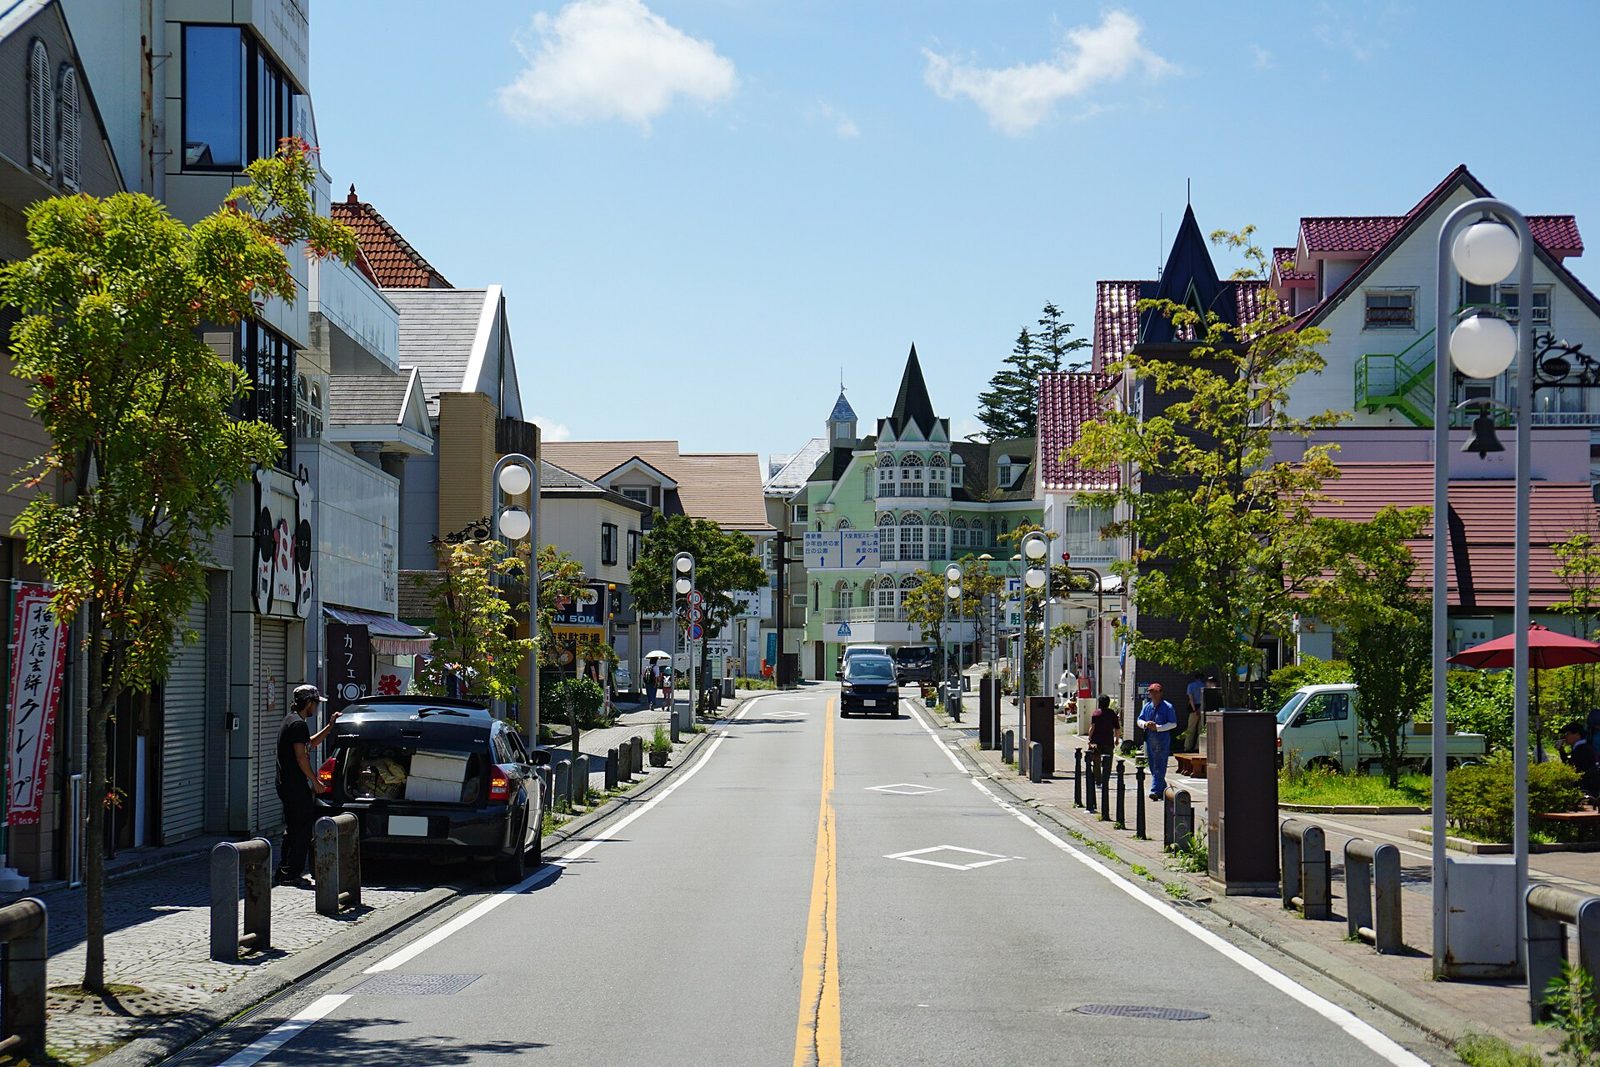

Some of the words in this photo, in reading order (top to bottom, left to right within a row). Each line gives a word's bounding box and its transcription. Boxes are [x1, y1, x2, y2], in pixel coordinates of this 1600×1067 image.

[569, 615, 595, 623] 50M
[343, 633, 357, 679] カフェ
[14, 606, 54, 802] 桔梗信玄餅クレープ
